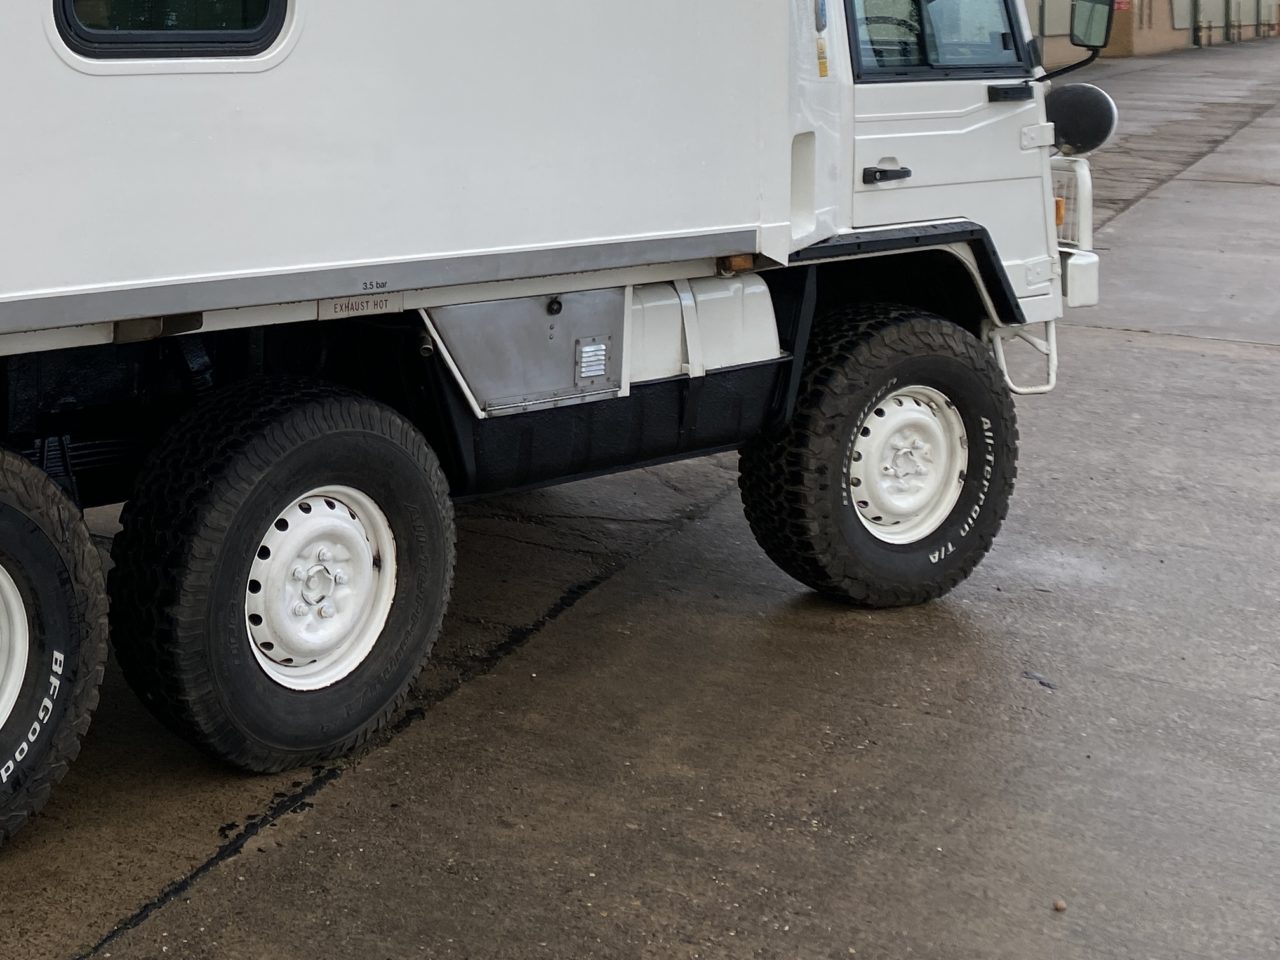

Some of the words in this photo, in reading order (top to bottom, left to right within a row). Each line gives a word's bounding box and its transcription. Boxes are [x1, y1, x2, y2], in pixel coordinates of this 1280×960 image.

[362, 281, 374, 291] 3.5
[375, 280, 388, 289] bar
[333, 300, 370, 314] EXHAUST
[373, 299, 389, 310] HOT
